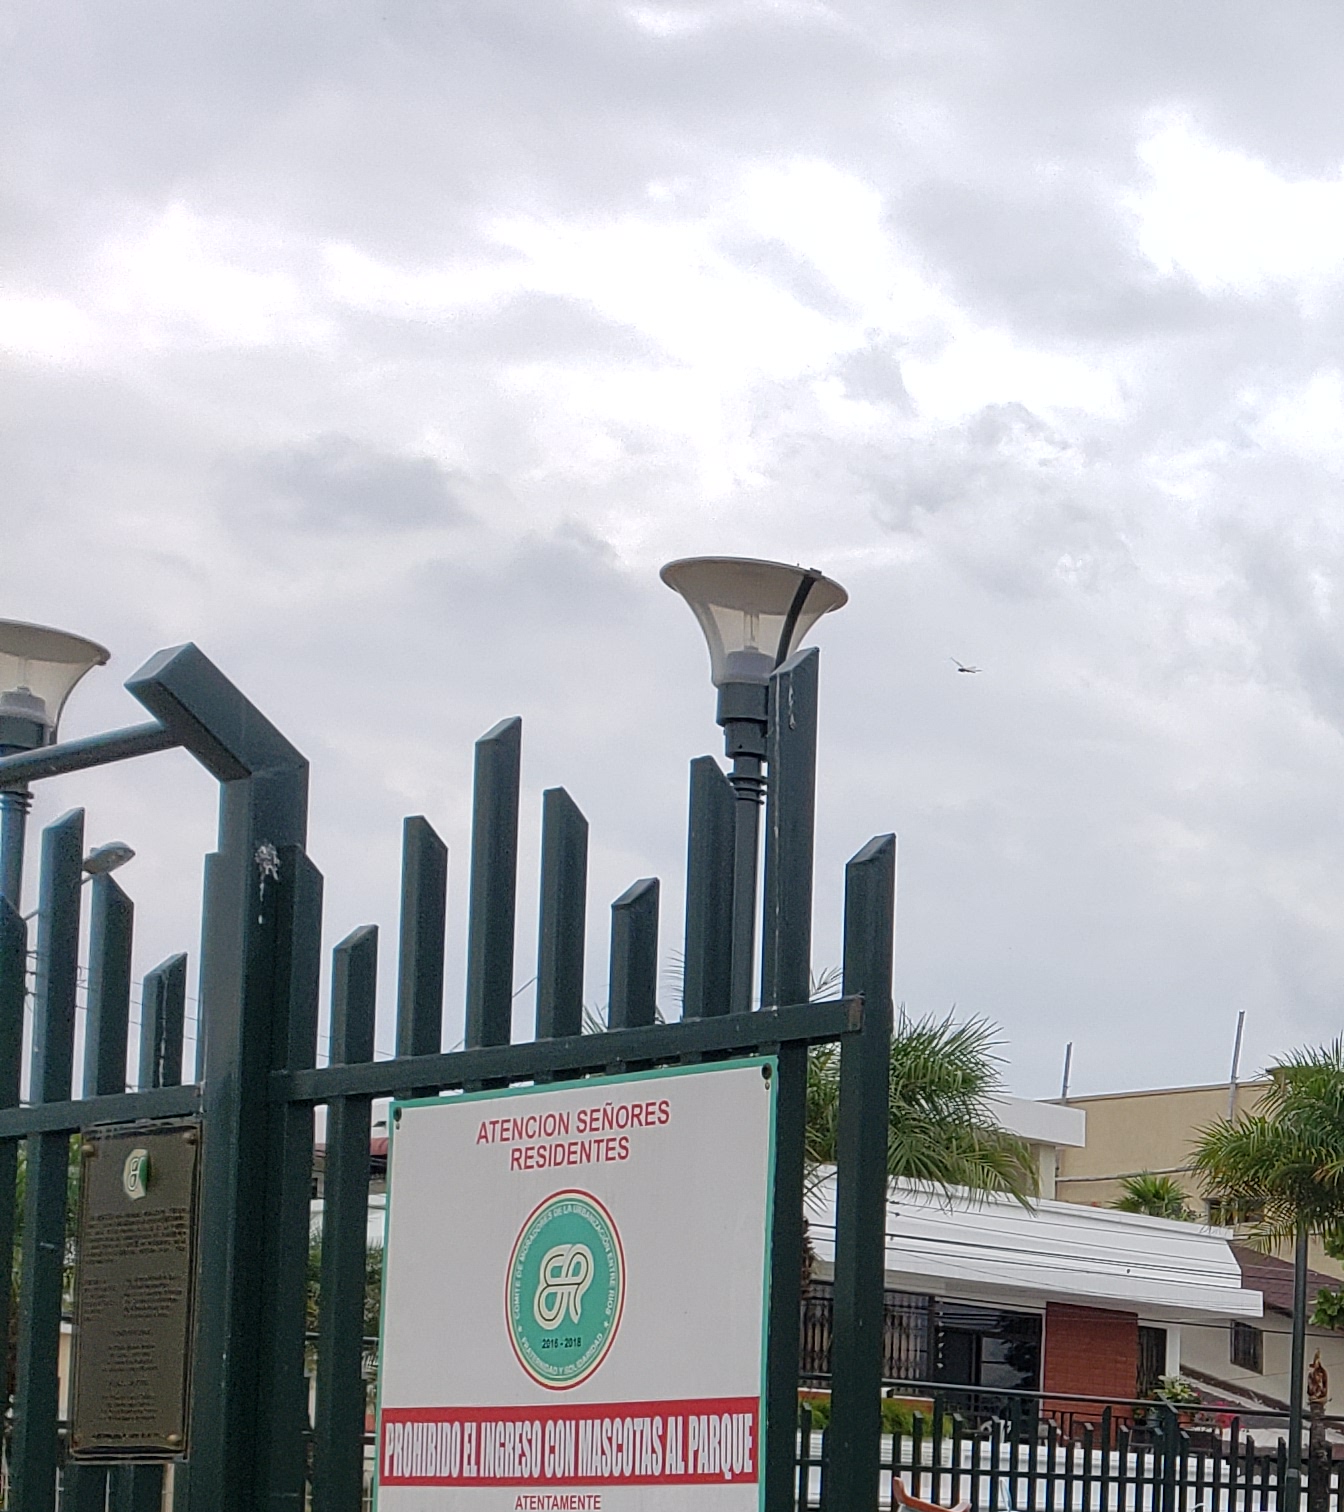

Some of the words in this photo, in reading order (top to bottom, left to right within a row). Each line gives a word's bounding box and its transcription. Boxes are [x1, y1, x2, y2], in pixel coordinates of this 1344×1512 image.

[476, 1110, 570, 1145] ATENCION
[576, 1099, 671, 1134] SEÑORES
[510, 1135, 630, 1172] RESIDENTES
[383, 1420, 461, 1478] PROHIBIDO
[462, 1420, 477, 1478] EL
[479, 1419, 541, 1478] INGRESO
[544, 1418, 575, 1478] CON
[577, 1413, 663, 1478] MASCOTAS
[665, 1413, 686, 1475] AL
[687, 1411, 754, 1481] PARQUE
[515, 1494, 602, 1512] ATENTAMENTE
